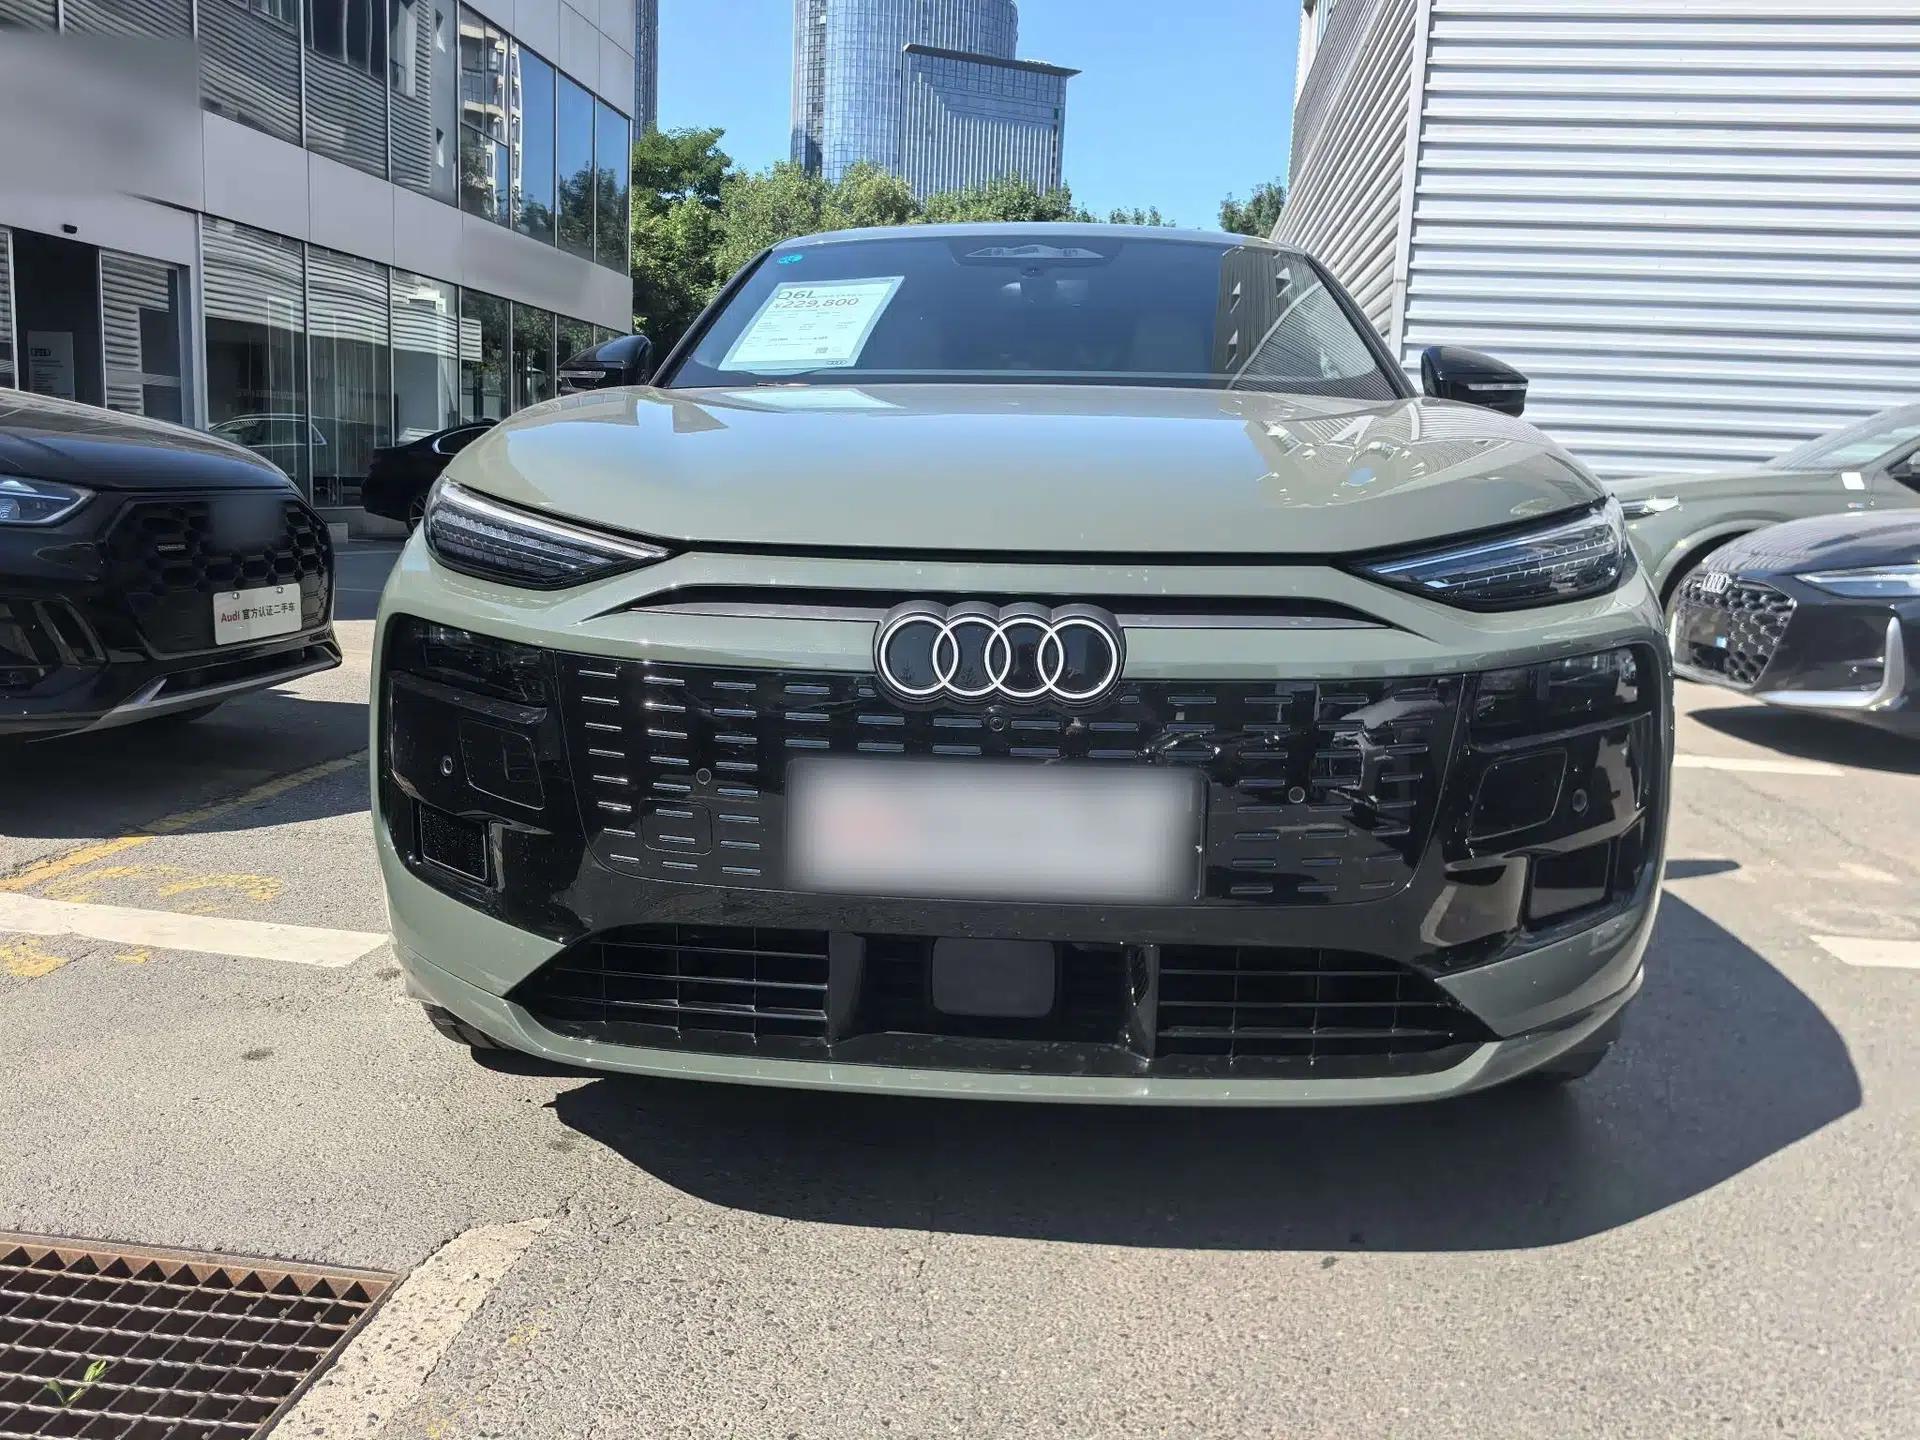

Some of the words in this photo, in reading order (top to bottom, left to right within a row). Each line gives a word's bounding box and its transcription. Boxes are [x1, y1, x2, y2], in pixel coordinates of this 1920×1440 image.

[220, 609, 240, 623] Audi
[242, 602, 296, 620] 官方认证二手车
